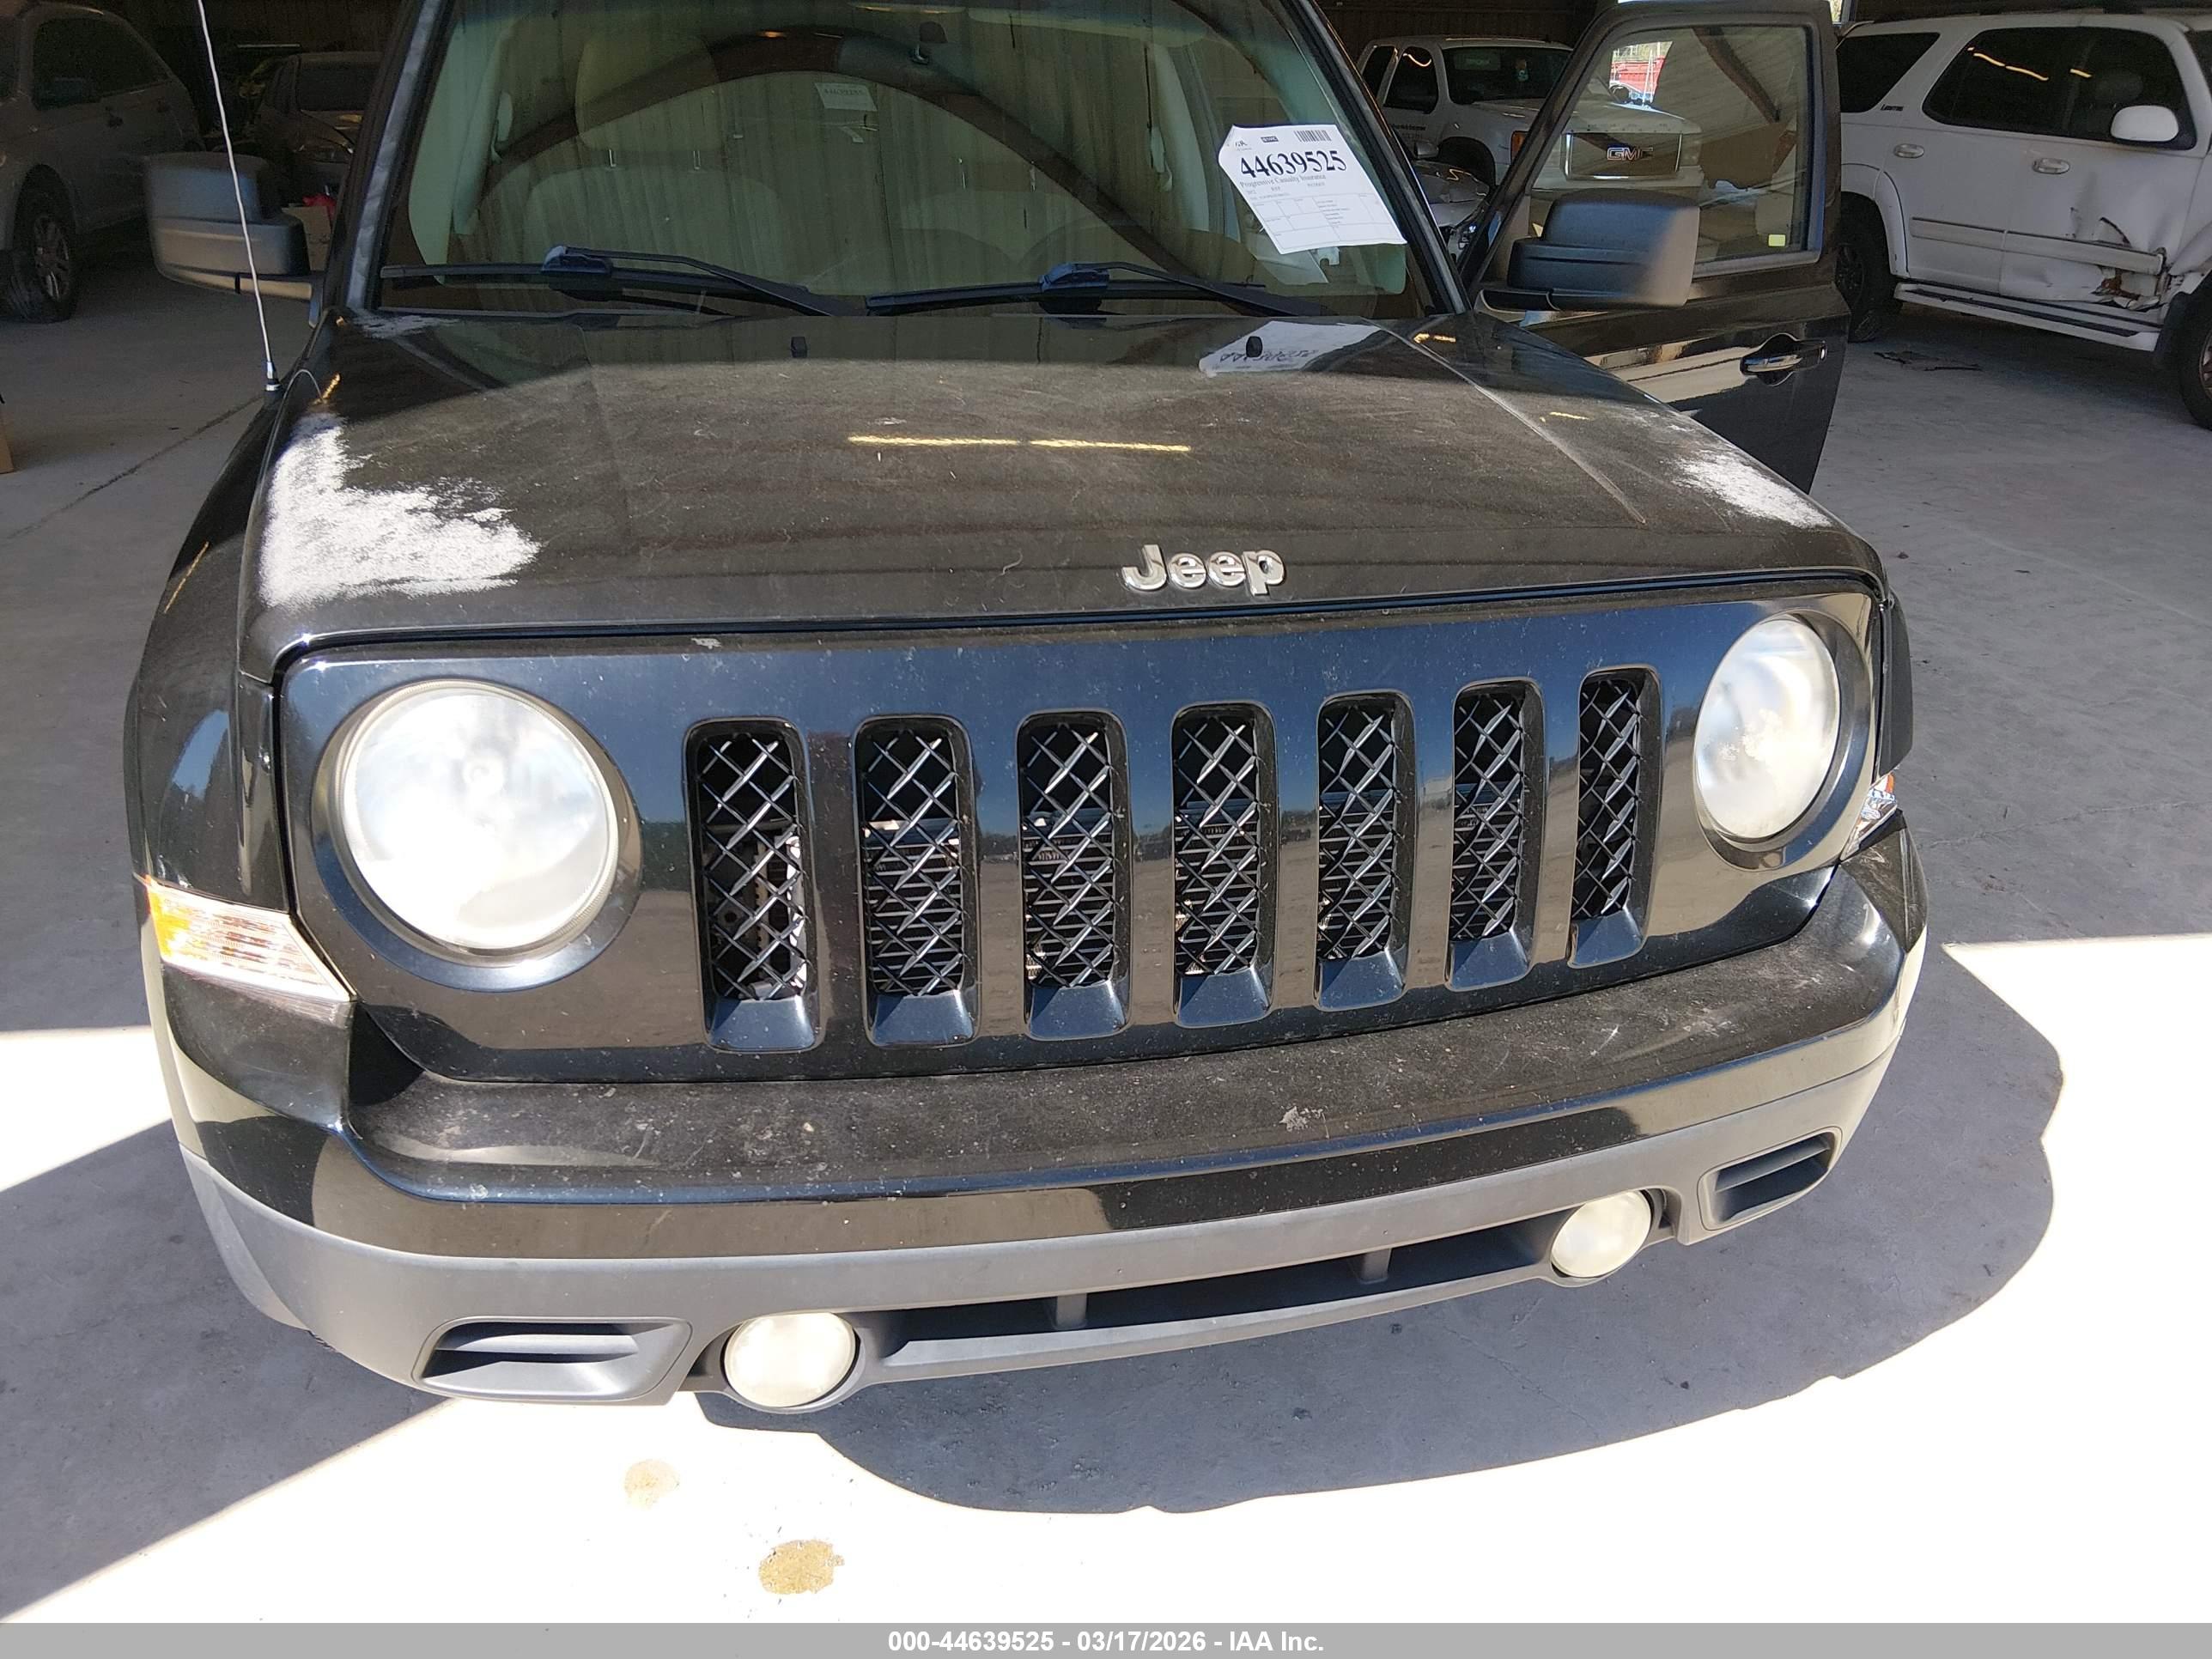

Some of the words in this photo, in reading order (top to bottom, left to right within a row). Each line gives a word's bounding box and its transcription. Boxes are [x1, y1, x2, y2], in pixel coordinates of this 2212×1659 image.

[1241, 150, 1346, 178] 44639525
[1607, 147, 1654, 161] GMC
[1121, 544, 1285, 595] Jeep
